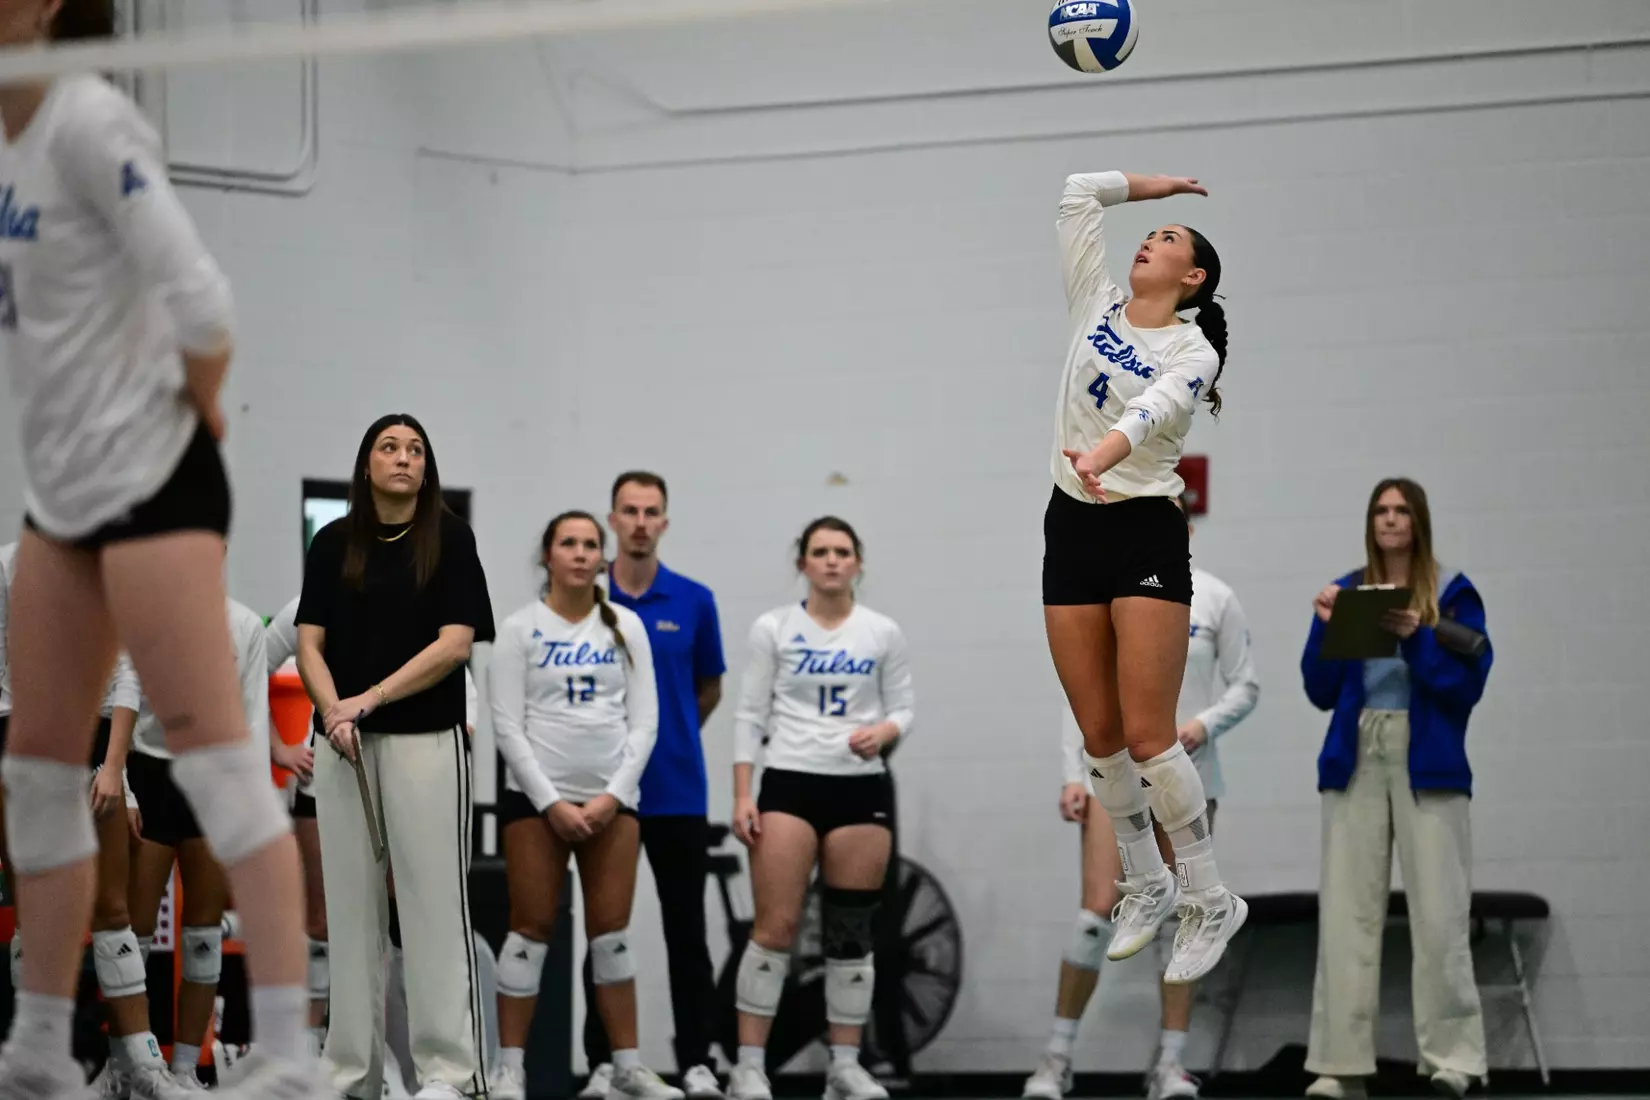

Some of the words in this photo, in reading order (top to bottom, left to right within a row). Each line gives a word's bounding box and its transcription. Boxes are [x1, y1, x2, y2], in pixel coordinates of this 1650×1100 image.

[1060, 3, 1098, 19] NCAA
[1087, 315, 1155, 379] Tulsa
[1088, 371, 1110, 410] 4
[538, 641, 616, 668] Tulsa
[792, 648, 876, 675] Tulsa
[566, 675, 596, 704] 12
[819, 684, 848, 717] 15
